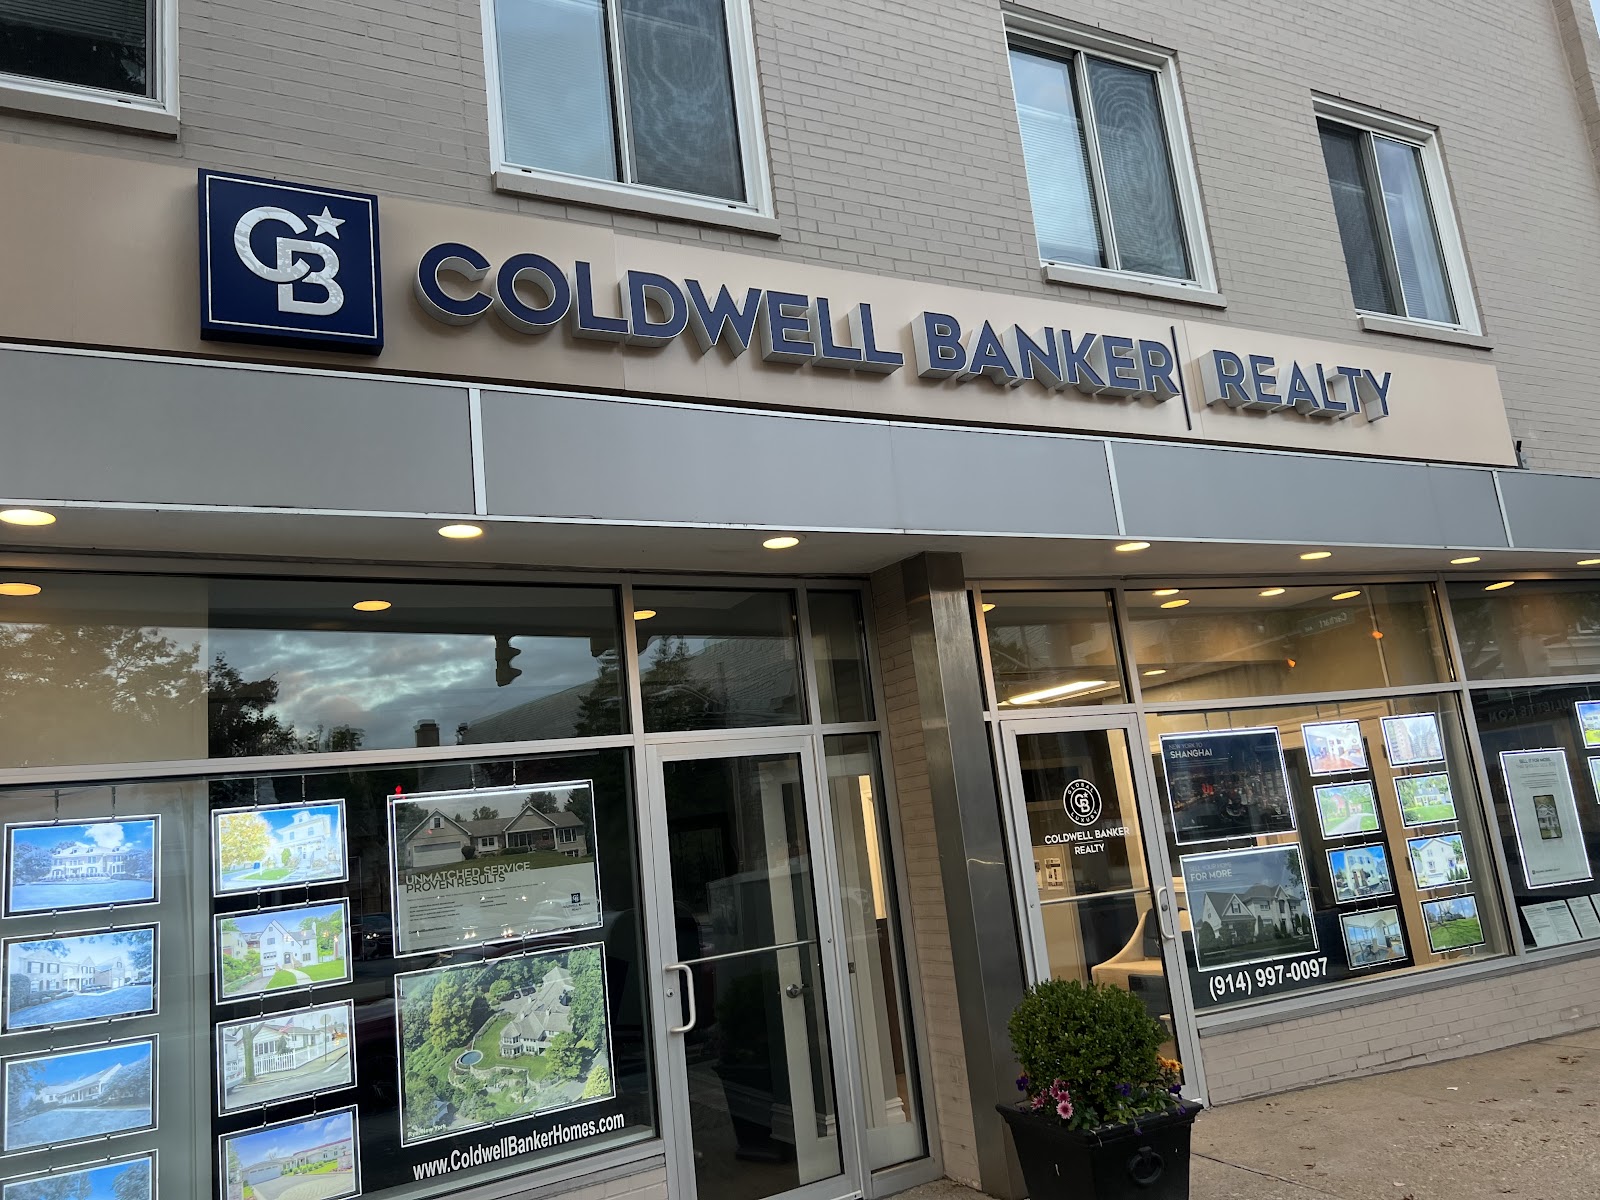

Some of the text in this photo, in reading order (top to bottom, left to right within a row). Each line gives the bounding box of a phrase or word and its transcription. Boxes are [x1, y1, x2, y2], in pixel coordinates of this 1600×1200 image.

[234, 206, 344, 316] CB
[417, 241, 1392, 416] COLDWELL BANKER REALTY
[1170, 748, 1213, 759] SHANGHAI
[1067, 782, 1094, 795] GLOBAL
[1070, 808, 1098, 823] LUXURY
[1044, 826, 1130, 844] COLDWELL BANKER
[1074, 843, 1105, 855] REALTY
[405, 861, 531, 885] UNMATCHED SERVICE
[1190, 868, 1233, 882] FOR MORE
[406, 878, 456, 894] PROVEN
[457, 873, 506, 888] RESULTS
[1209, 956, 1328, 1001] (914) 997-0097
[413, 1112, 625, 1181] www.ColdwellBankerHomes.com
